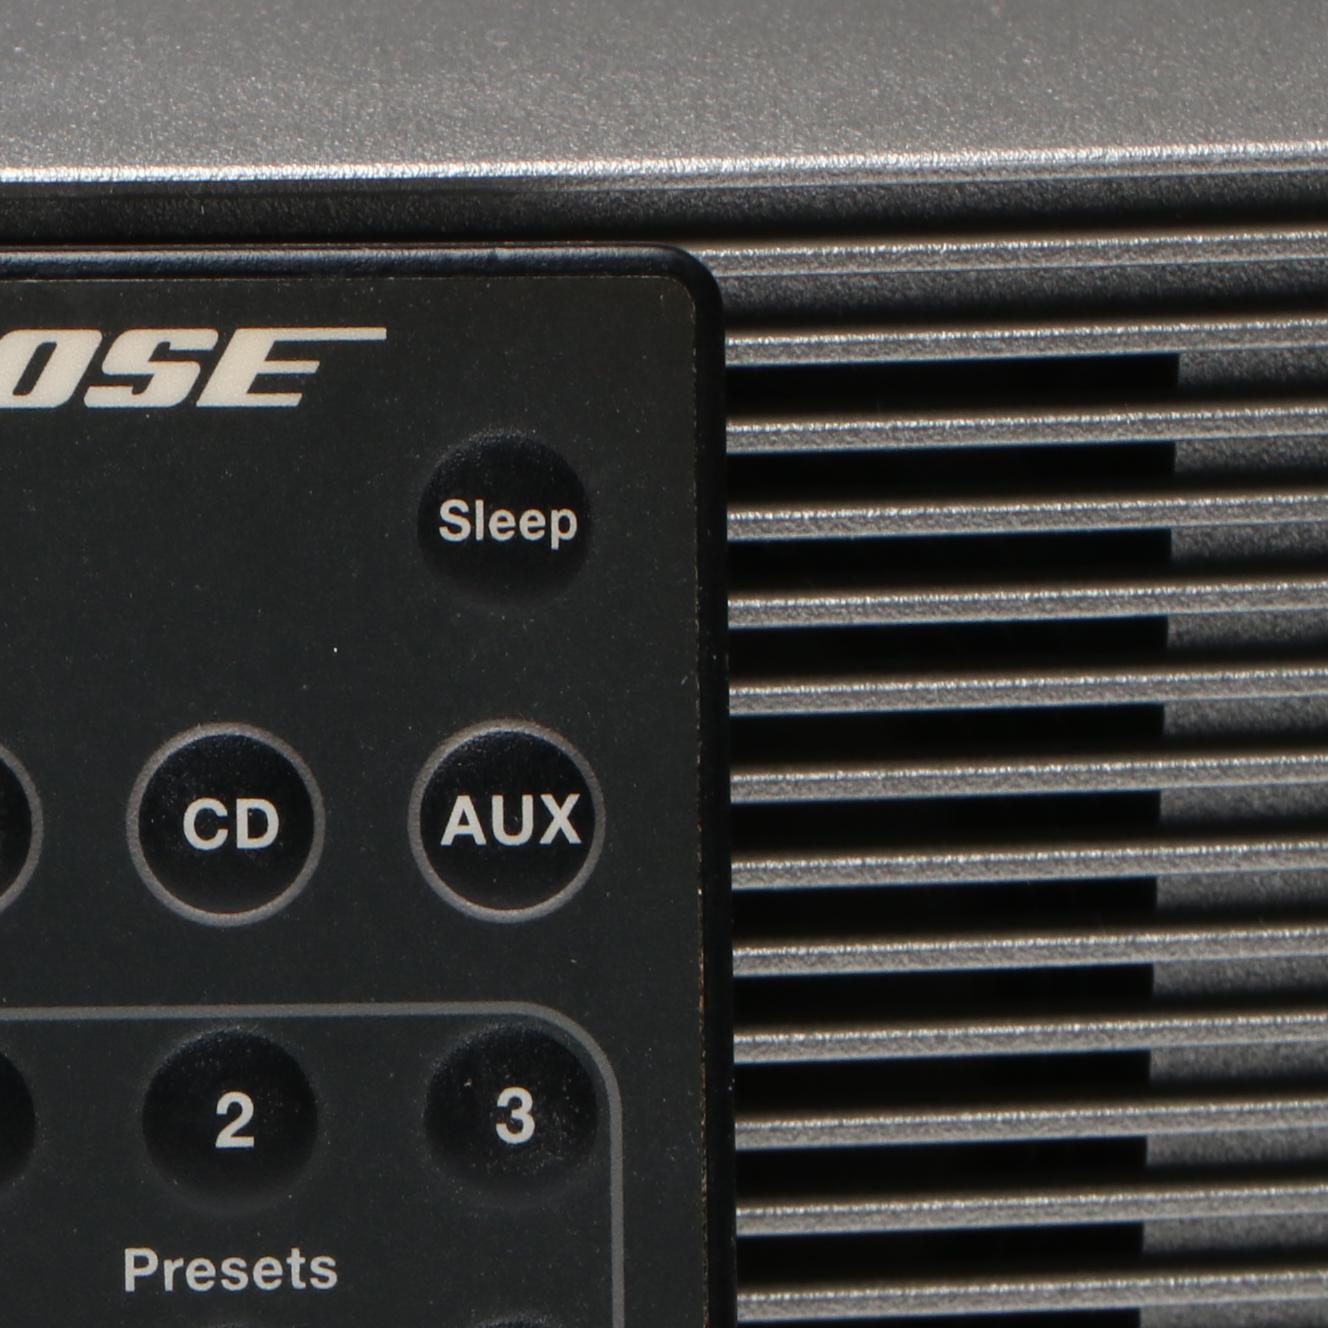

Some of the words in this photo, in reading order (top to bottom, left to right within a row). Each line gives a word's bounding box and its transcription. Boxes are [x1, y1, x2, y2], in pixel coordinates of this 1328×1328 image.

[439, 498, 578, 550] Sleep
[183, 797, 280, 851] CD
[440, 793, 581, 846] AUX
[215, 1091, 255, 1148] 2
[495, 1087, 536, 1145] 3
[124, 1247, 338, 1292] Presets
